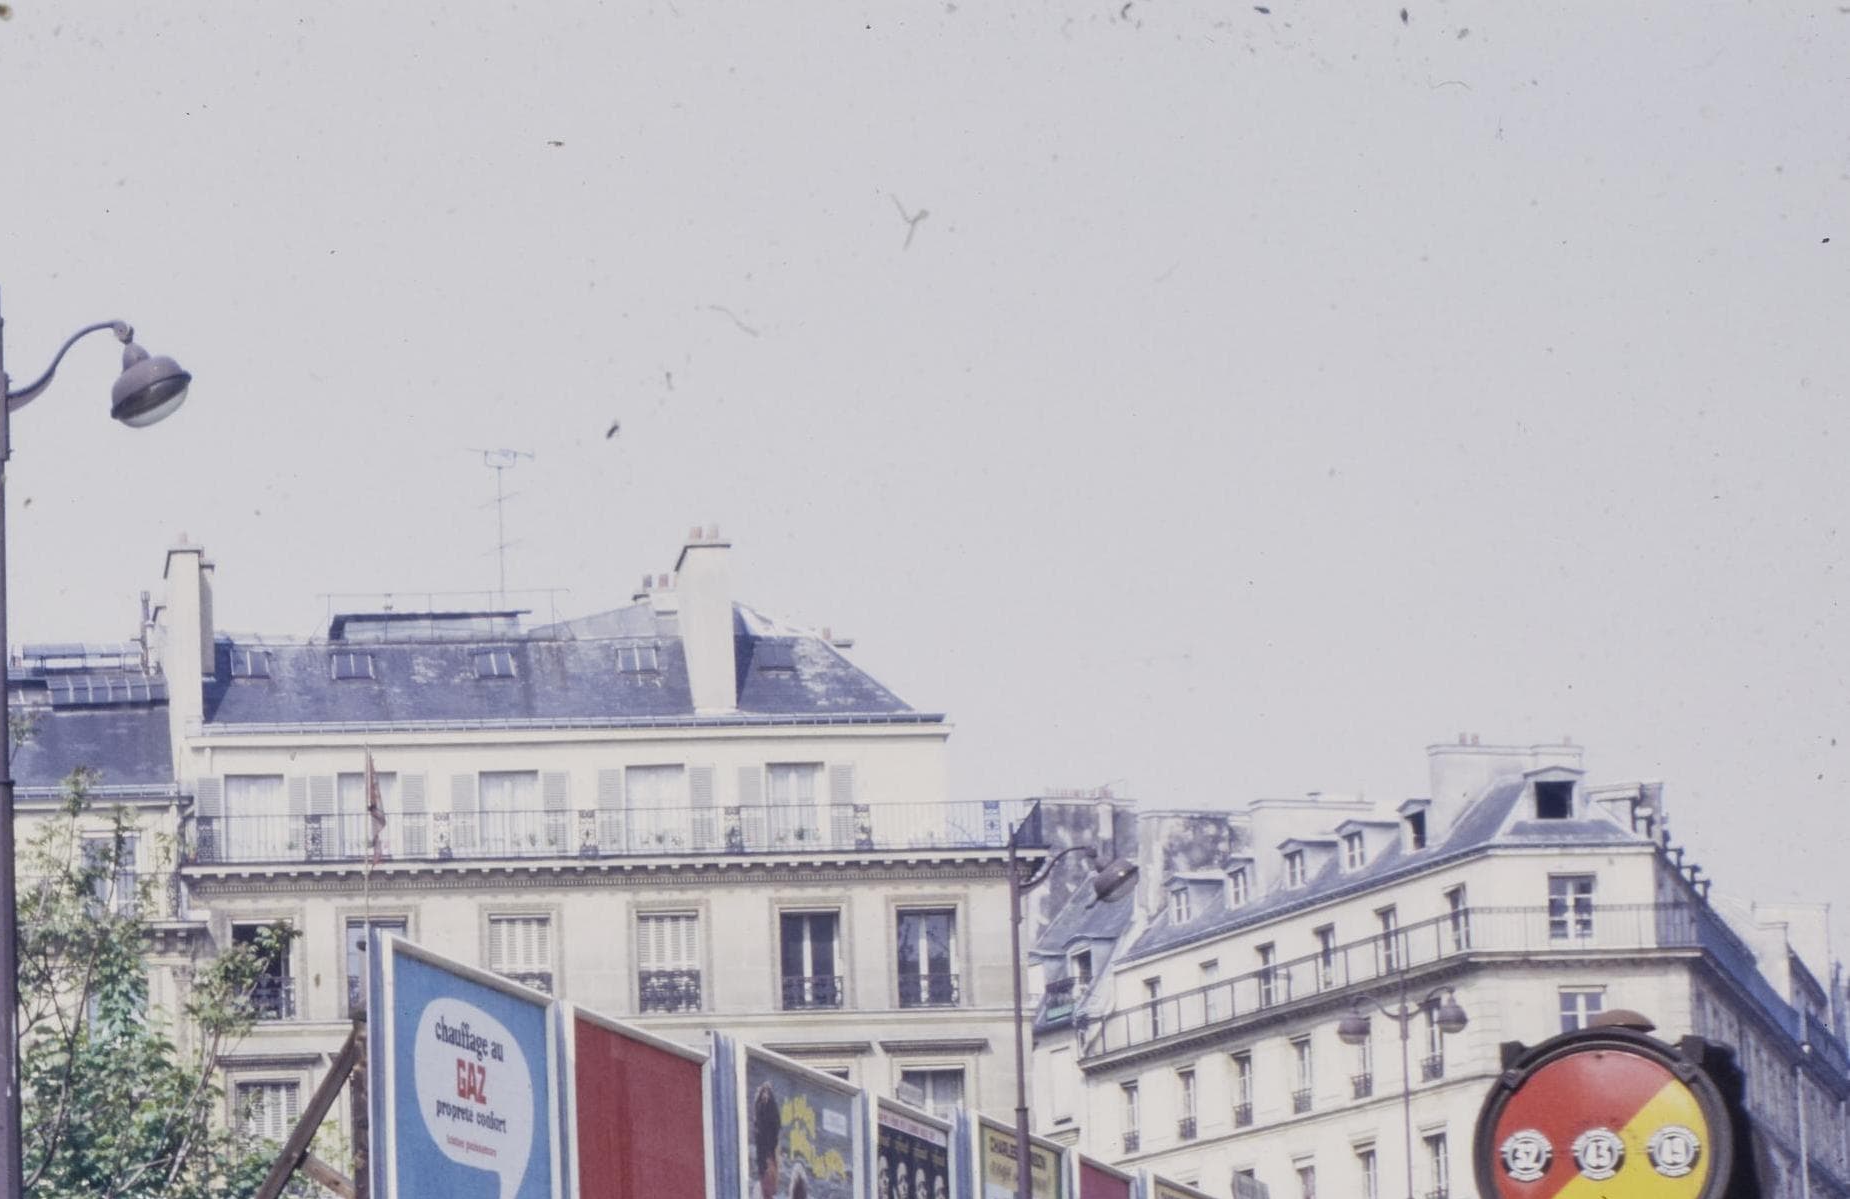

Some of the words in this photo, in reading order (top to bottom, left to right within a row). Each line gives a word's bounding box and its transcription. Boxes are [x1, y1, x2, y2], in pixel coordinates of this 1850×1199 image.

[435, 1016, 488, 1061] chauffage
[491, 1041, 504, 1062] au
[457, 1058, 487, 1105] GAZ
[476, 1110, 507, 1133] confort
